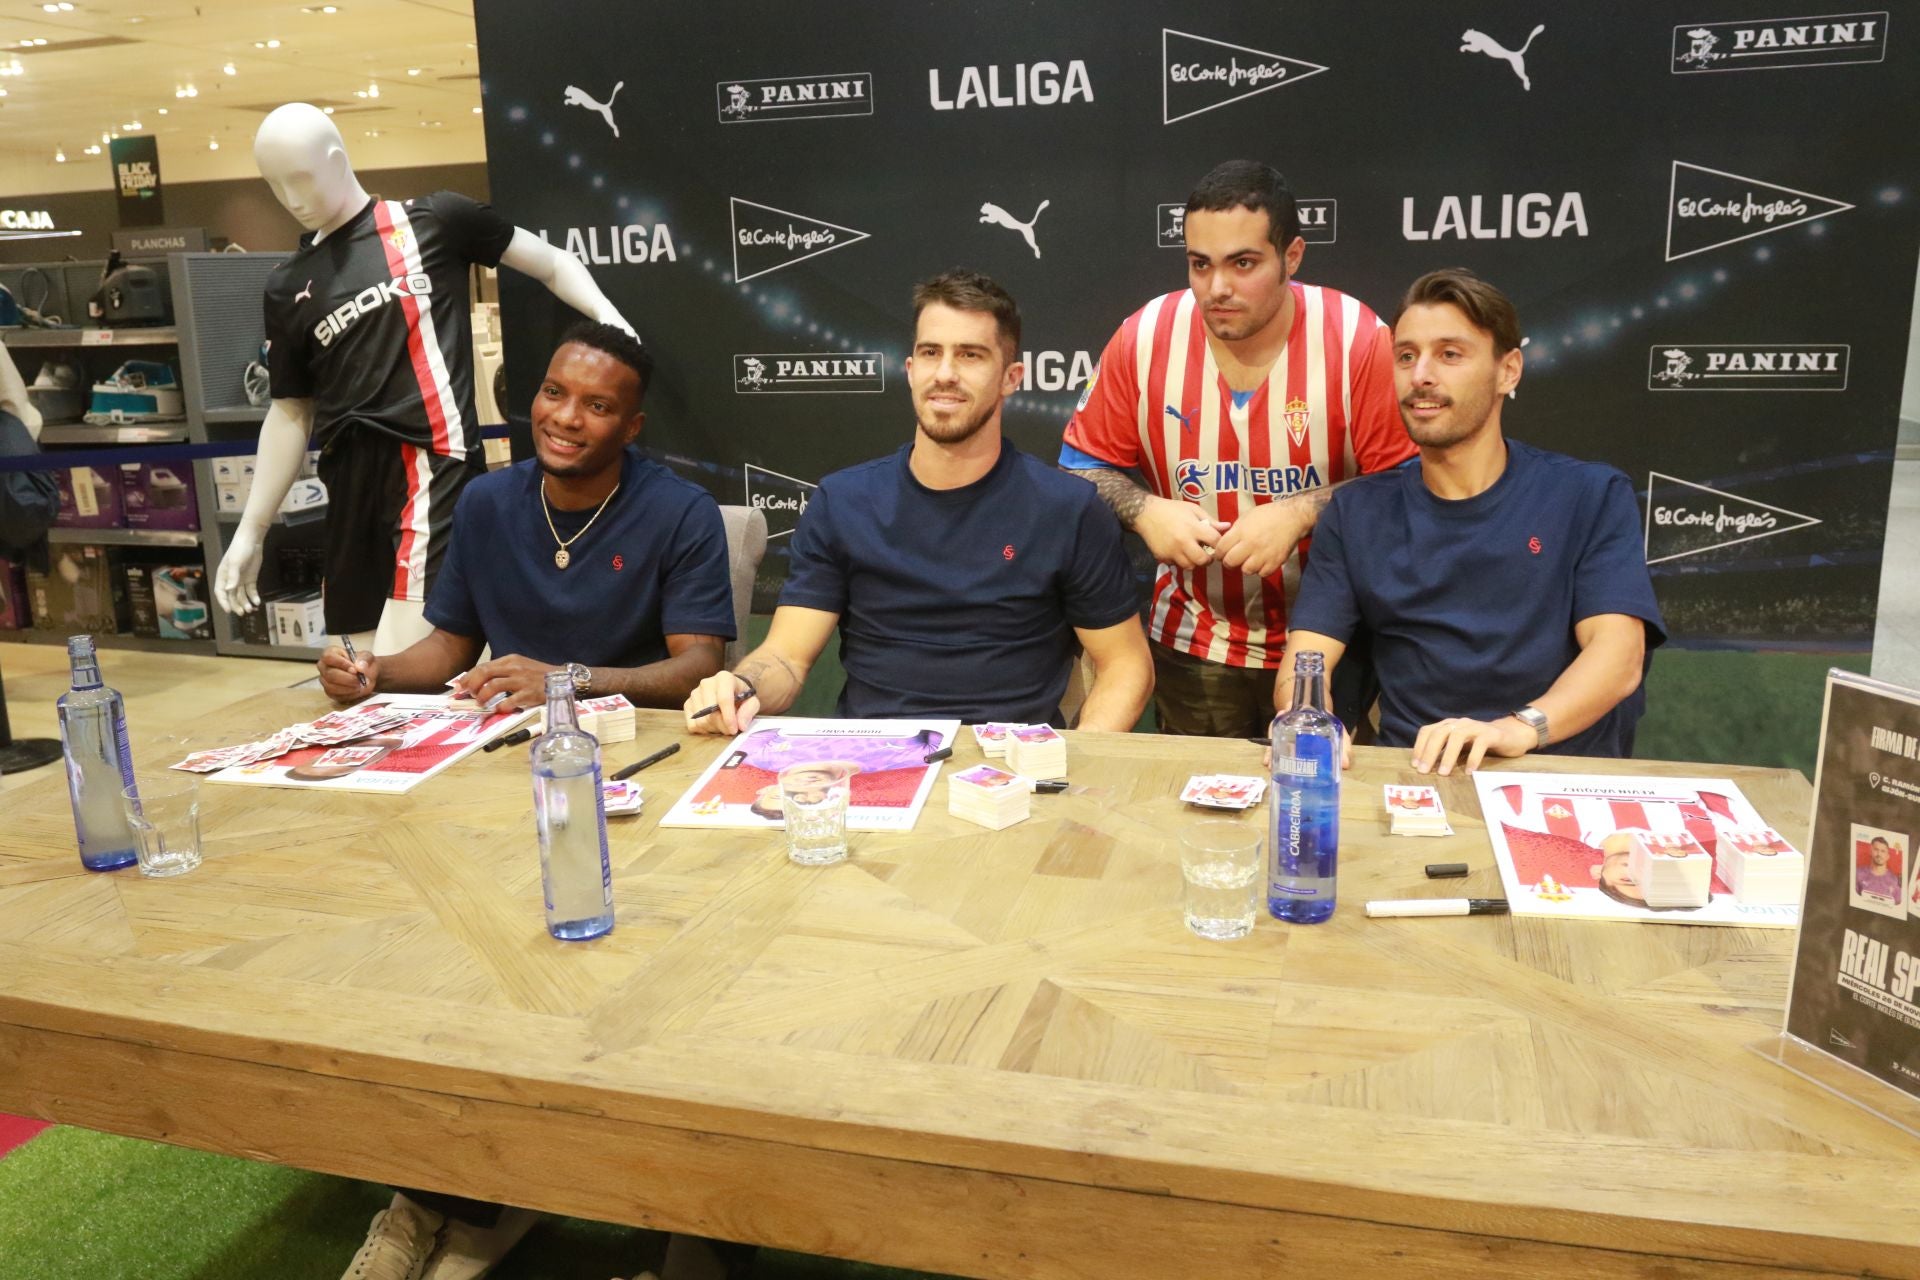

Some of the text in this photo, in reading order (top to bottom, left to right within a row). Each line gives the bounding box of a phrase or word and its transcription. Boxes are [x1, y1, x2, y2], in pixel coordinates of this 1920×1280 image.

[1733, 21, 1877, 50] PANINI
[1170, 63, 1187, 83] El
[1188, 63, 1228, 82] Corte
[760, 80, 864, 103] PANINI
[928, 59, 1095, 111] LALIGA
[1402, 191, 1589, 241] LALIGA
[1677, 197, 1697, 217] El
[1697, 197, 1741, 218] Corte
[0, 209, 55, 230] CAJA
[131, 237, 186, 250] PLANCHAS
[738, 228, 753, 246] El
[753, 228, 787, 246] Corte
[313, 273, 432, 347] SIROKO
[776, 358, 876, 378] PANINI
[1705, 352, 1840, 371] PANINI
[1215, 462, 1322, 495] INTEGRA
[766, 494, 798, 510] Corte
[1654, 506, 1673, 526] El
[1673, 507, 1714, 527] Corte
[1871, 725, 1904, 756] FIRMA
[1903, 735, 1918, 760] DE
[1839, 927, 1889, 991] REAL
